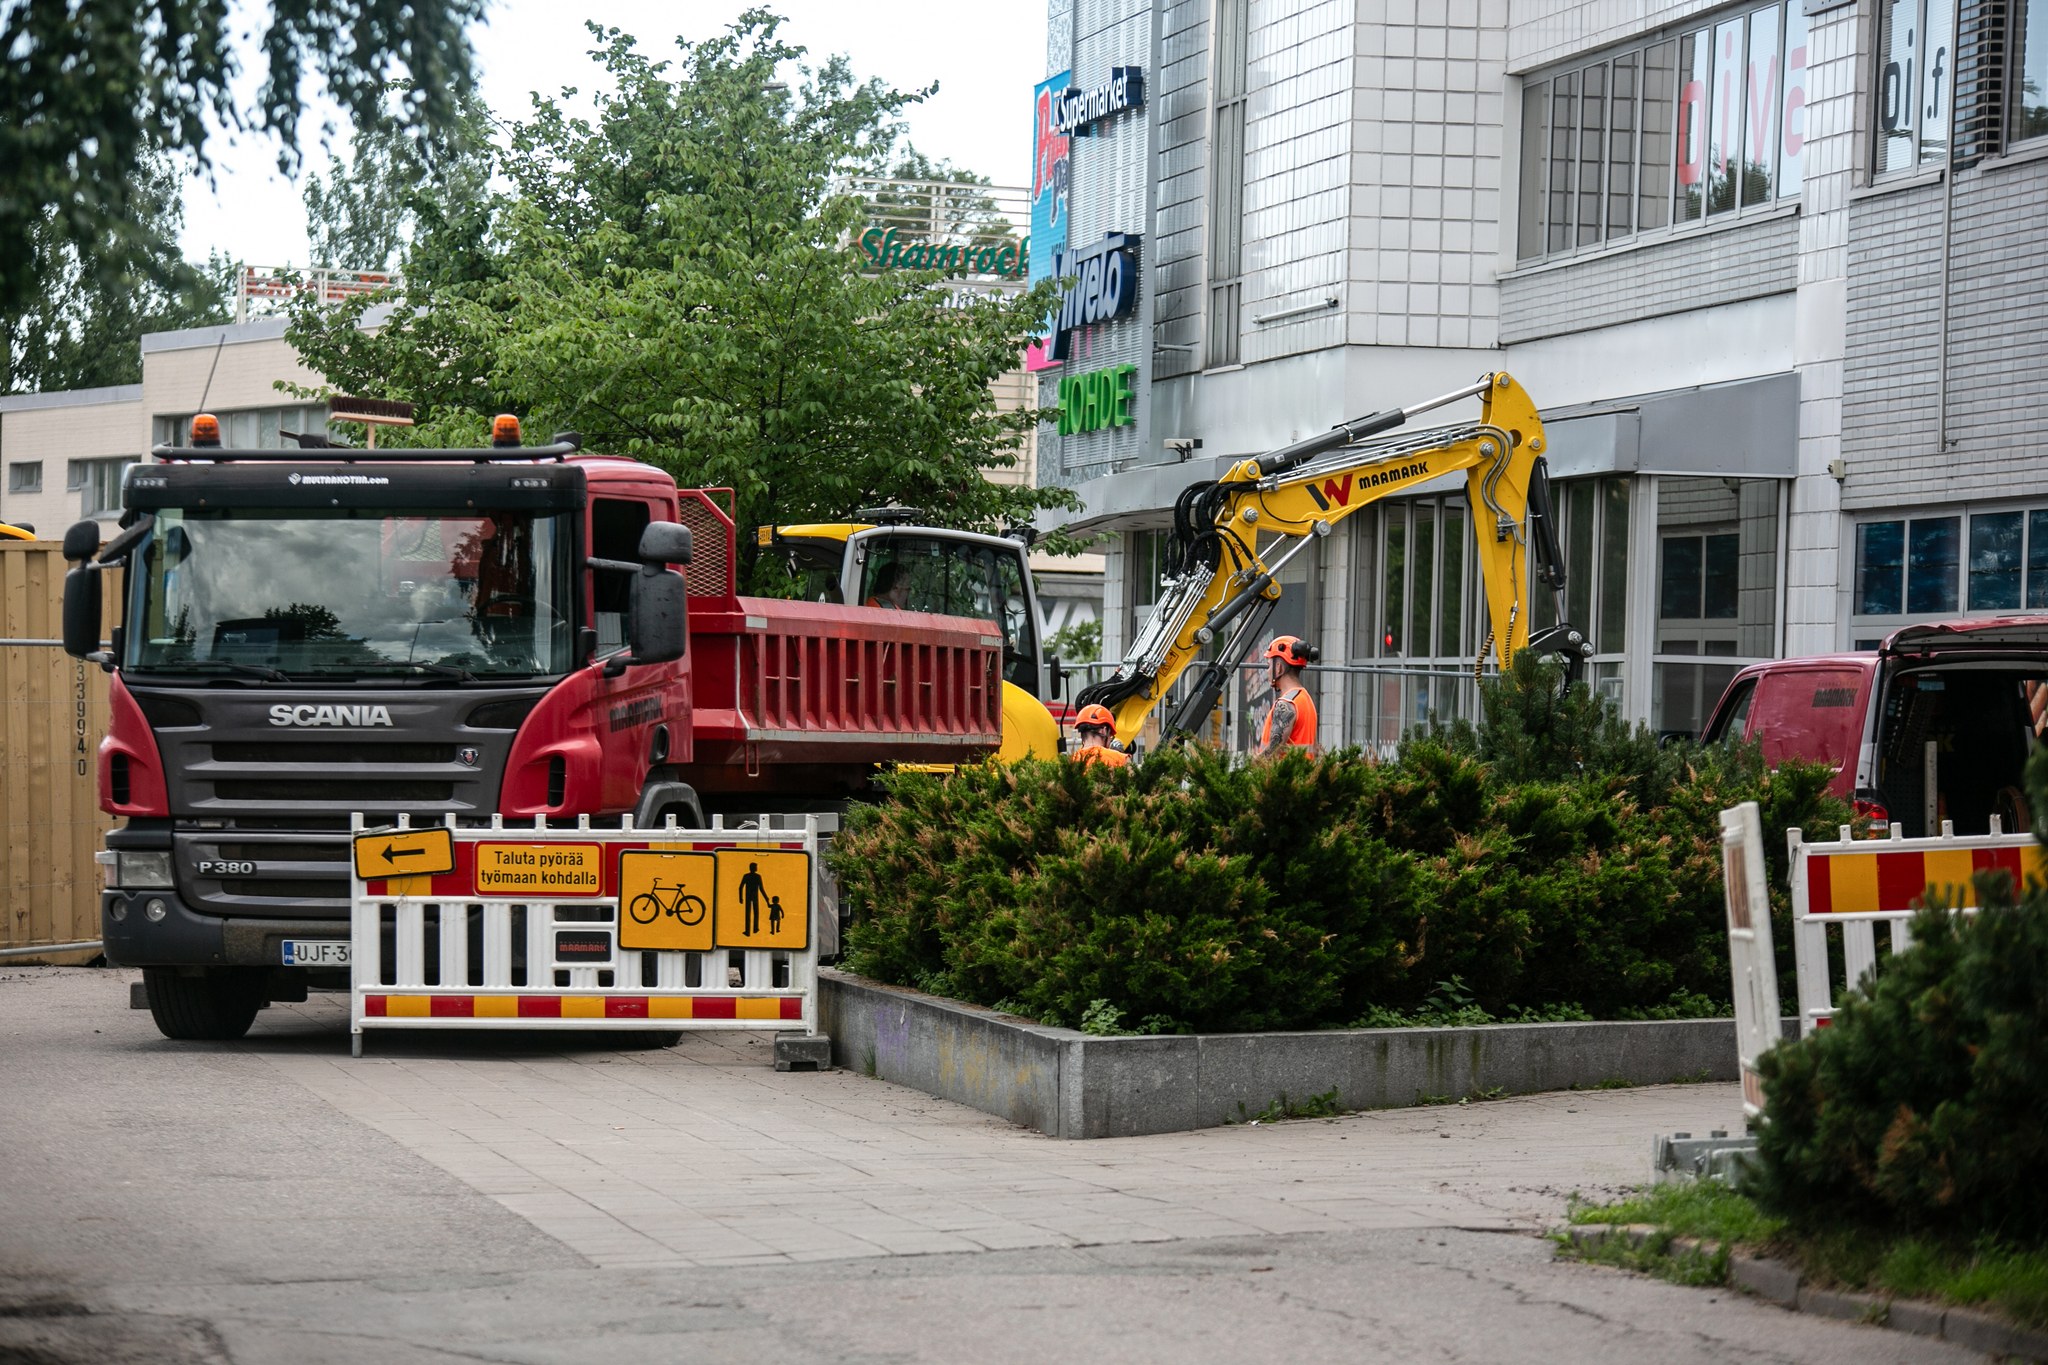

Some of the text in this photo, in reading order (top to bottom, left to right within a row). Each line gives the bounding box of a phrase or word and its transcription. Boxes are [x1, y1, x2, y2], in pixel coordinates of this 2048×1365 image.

[1060, 67, 1128, 137] Supermarket
[1057, 364, 1137, 436] HOHDE
[1358, 461, 1429, 490] MAAMARK
[269, 704, 394, 727] SCANIA
[199, 861, 254, 874] P 380
[494, 850, 584, 868] Taluta pyörää
[481, 869, 597, 885] työmaan kohdalla
